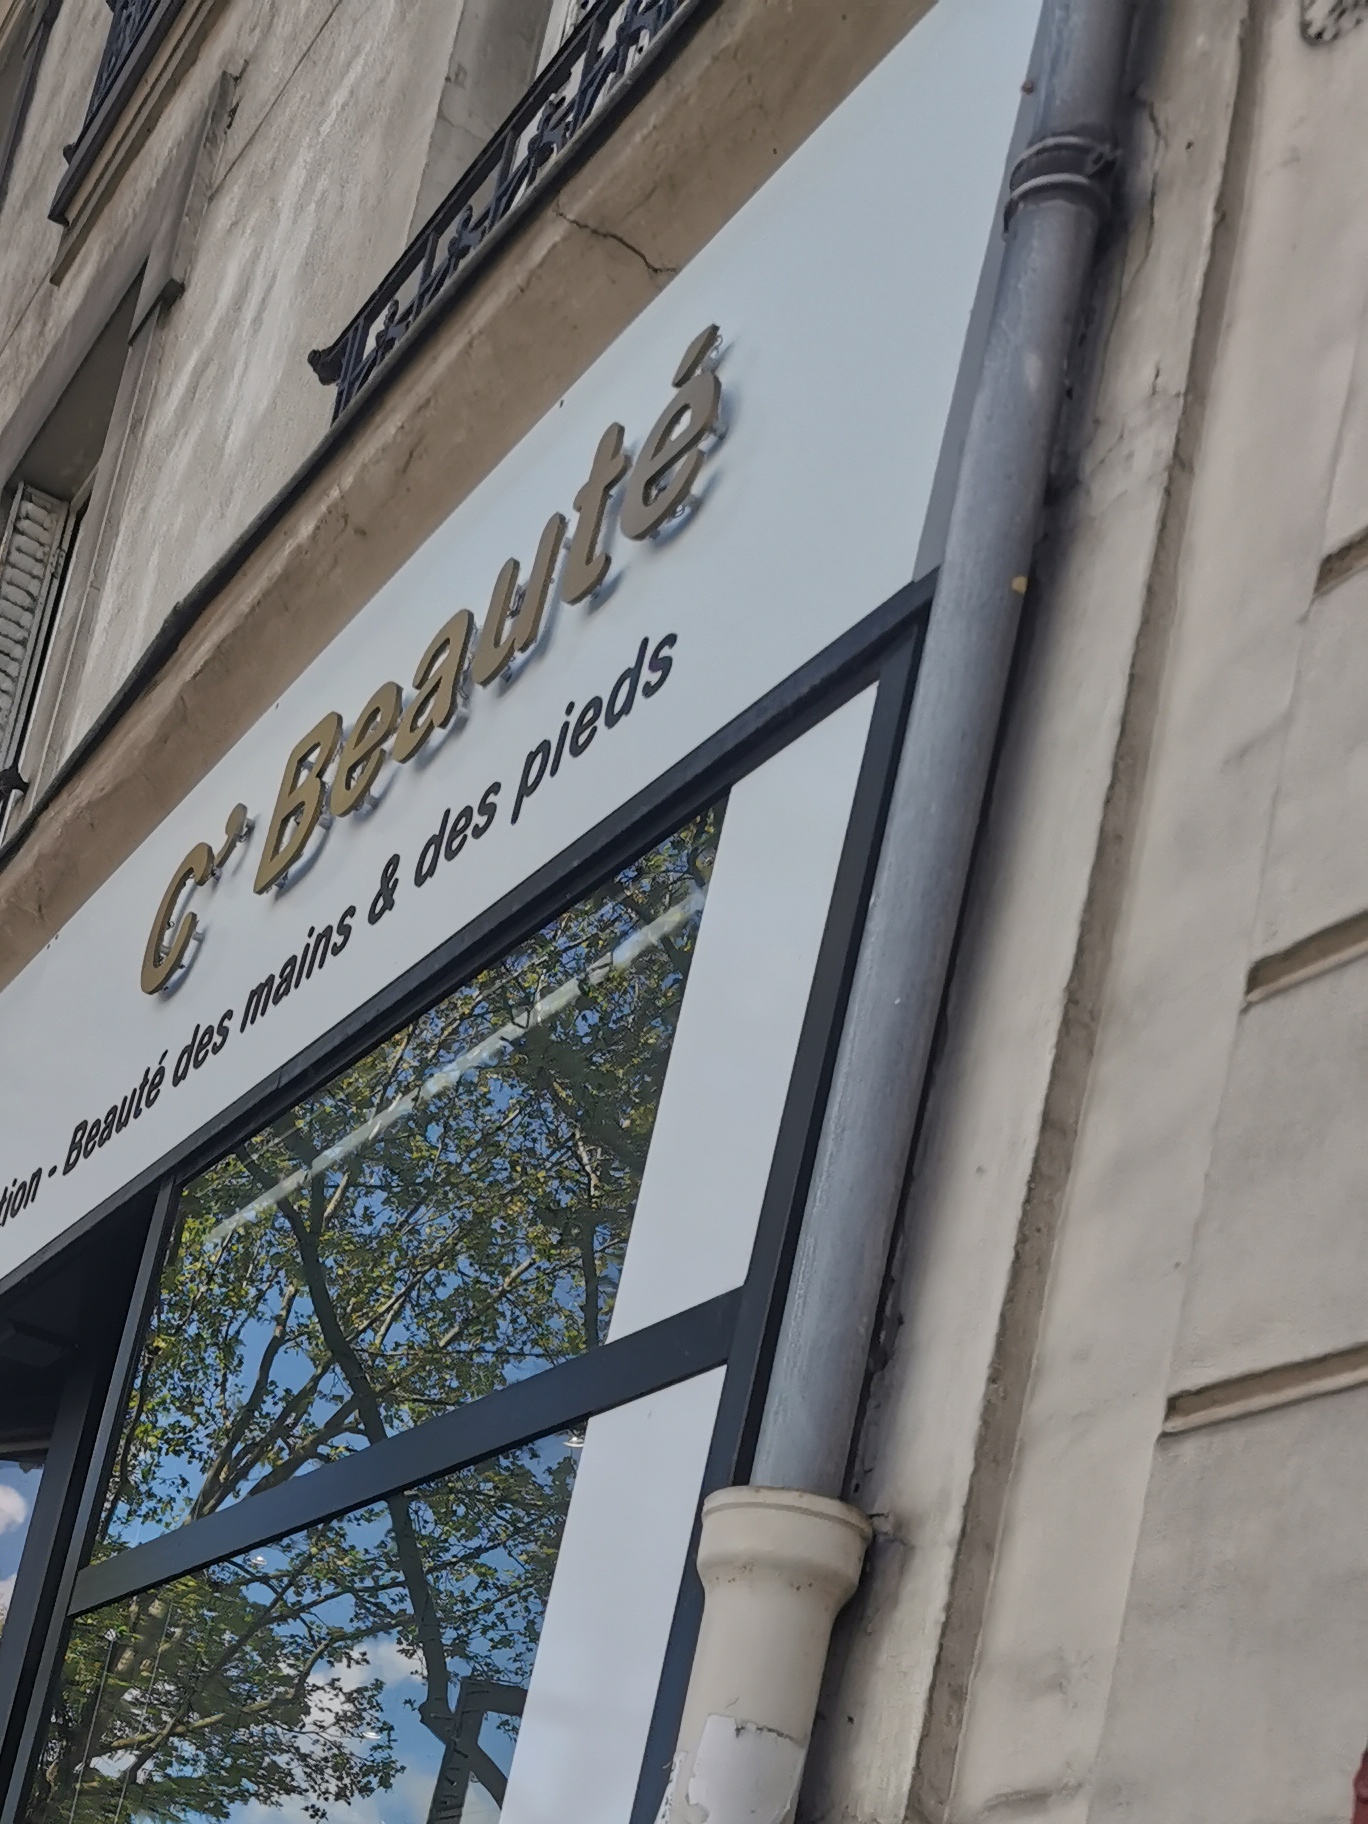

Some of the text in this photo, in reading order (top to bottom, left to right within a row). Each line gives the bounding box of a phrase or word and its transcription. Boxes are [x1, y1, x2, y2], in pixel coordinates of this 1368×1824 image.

[253, 324, 721, 894] Beauté
[63, 1050, 168, 1175] Beauté
[172, 1009, 233, 1087] des
[240, 905, 356, 1033] mains
[367, 854, 400, 925] &
[414, 781, 501, 888] des
[511, 633, 678, 825] pieds
